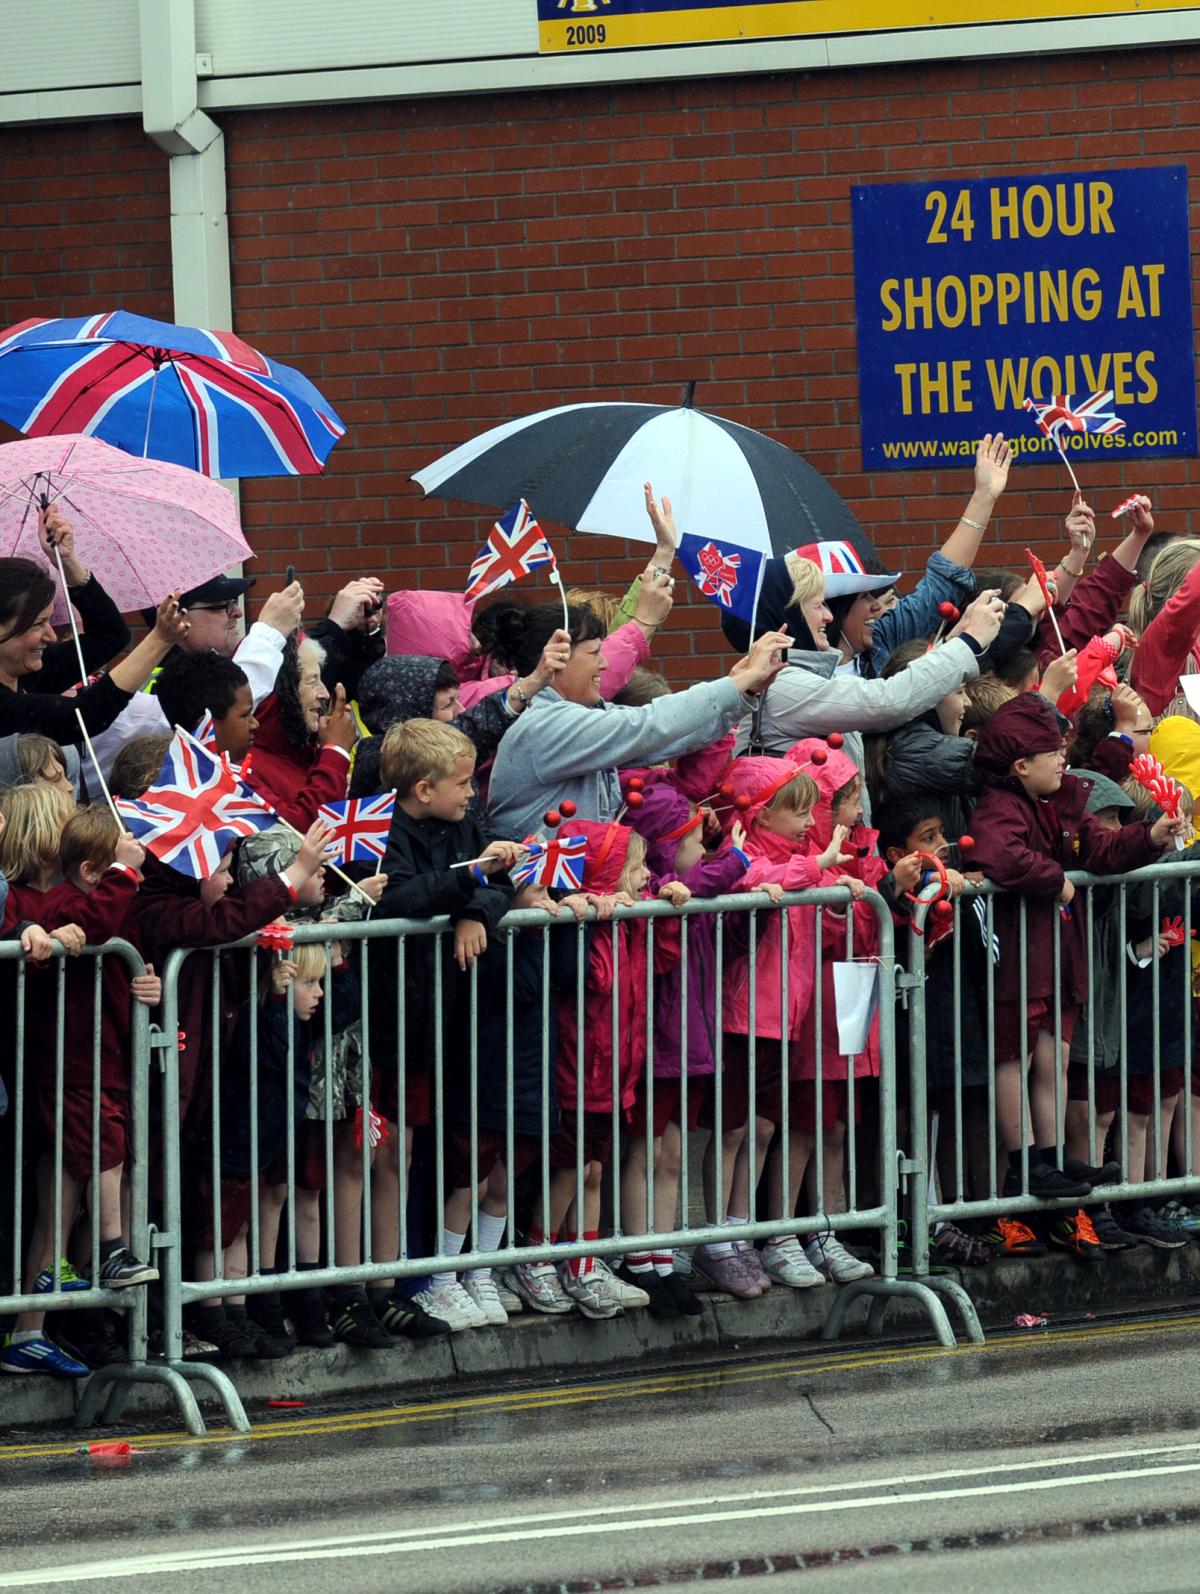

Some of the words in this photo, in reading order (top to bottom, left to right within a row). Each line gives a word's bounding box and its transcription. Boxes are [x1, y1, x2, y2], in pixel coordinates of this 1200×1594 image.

[566, 24, 606, 45] 2009
[925, 190, 975, 244] 24
[990, 181, 1116, 240] HOUR
[880, 267, 1103, 332] SHOPPING
[1116, 263, 1165, 319] AT
[894, 360, 973, 416] THE
[882, 429, 1178, 459] www.wargtonolves.com
